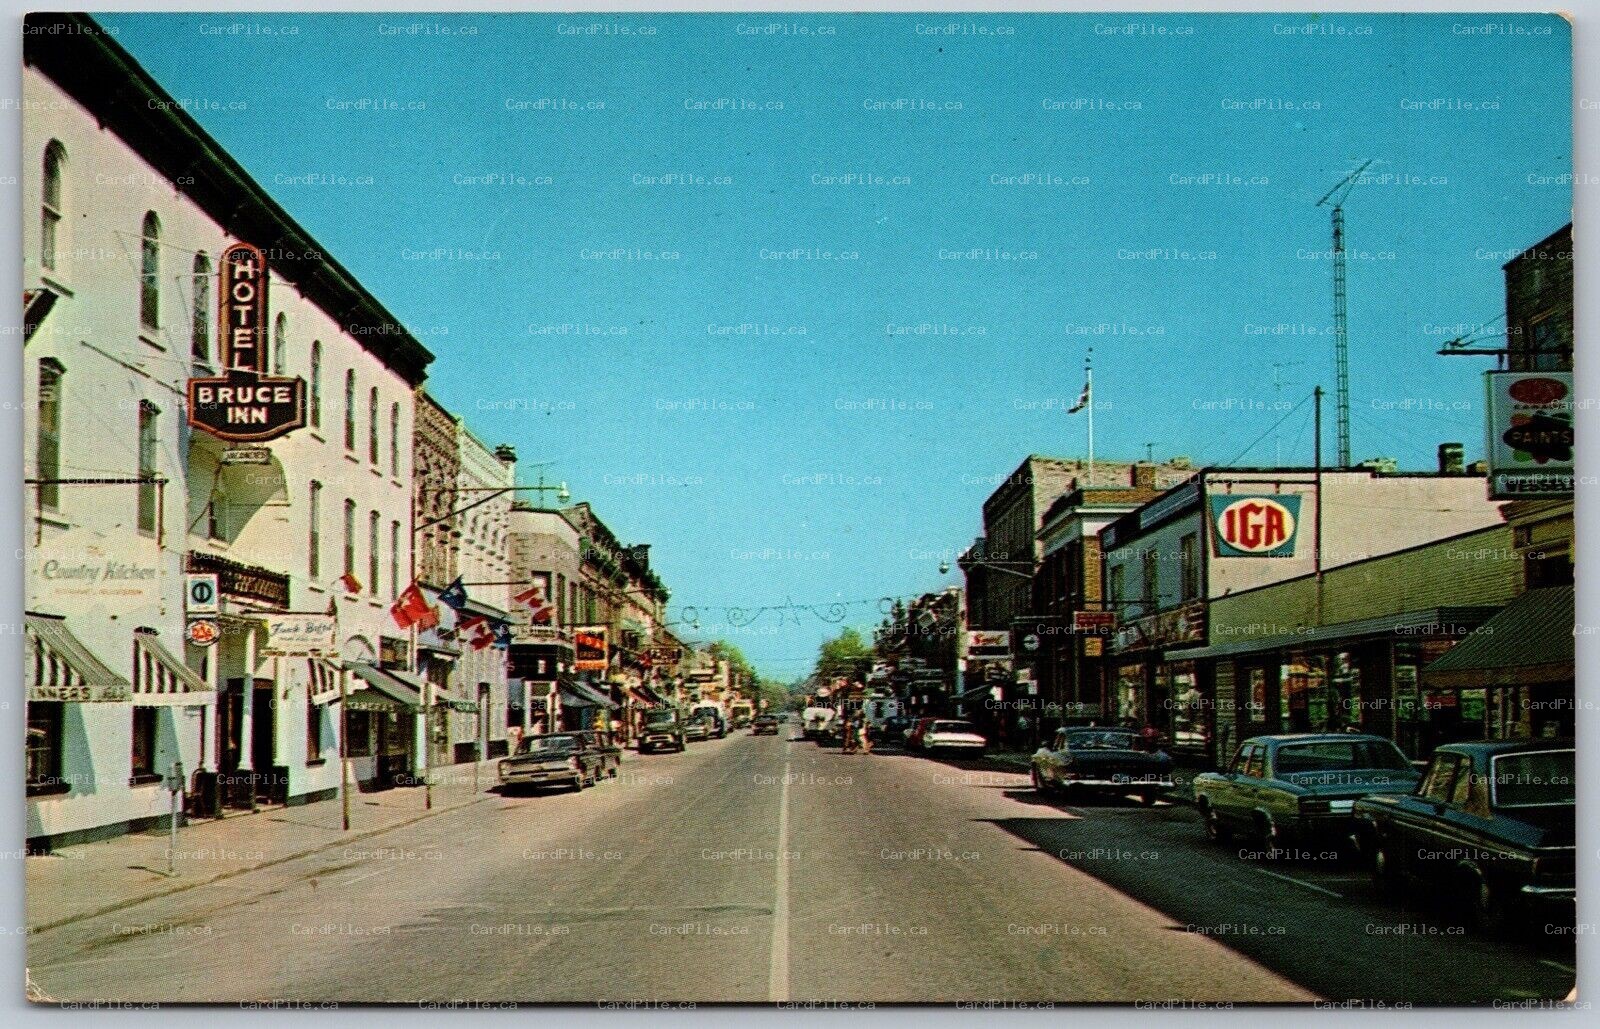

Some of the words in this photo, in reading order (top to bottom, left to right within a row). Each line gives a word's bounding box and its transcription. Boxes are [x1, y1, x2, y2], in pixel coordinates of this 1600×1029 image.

[233, 259, 256, 372] HOTEL
[198, 386, 292, 404] BRUCE
[227, 406, 268, 425] INN
[1511, 431, 1571, 443] PAINTS
[1225, 503, 1286, 549] IGA
[43, 559, 101, 586] Country
[101, 561, 156, 582] Kitchen
